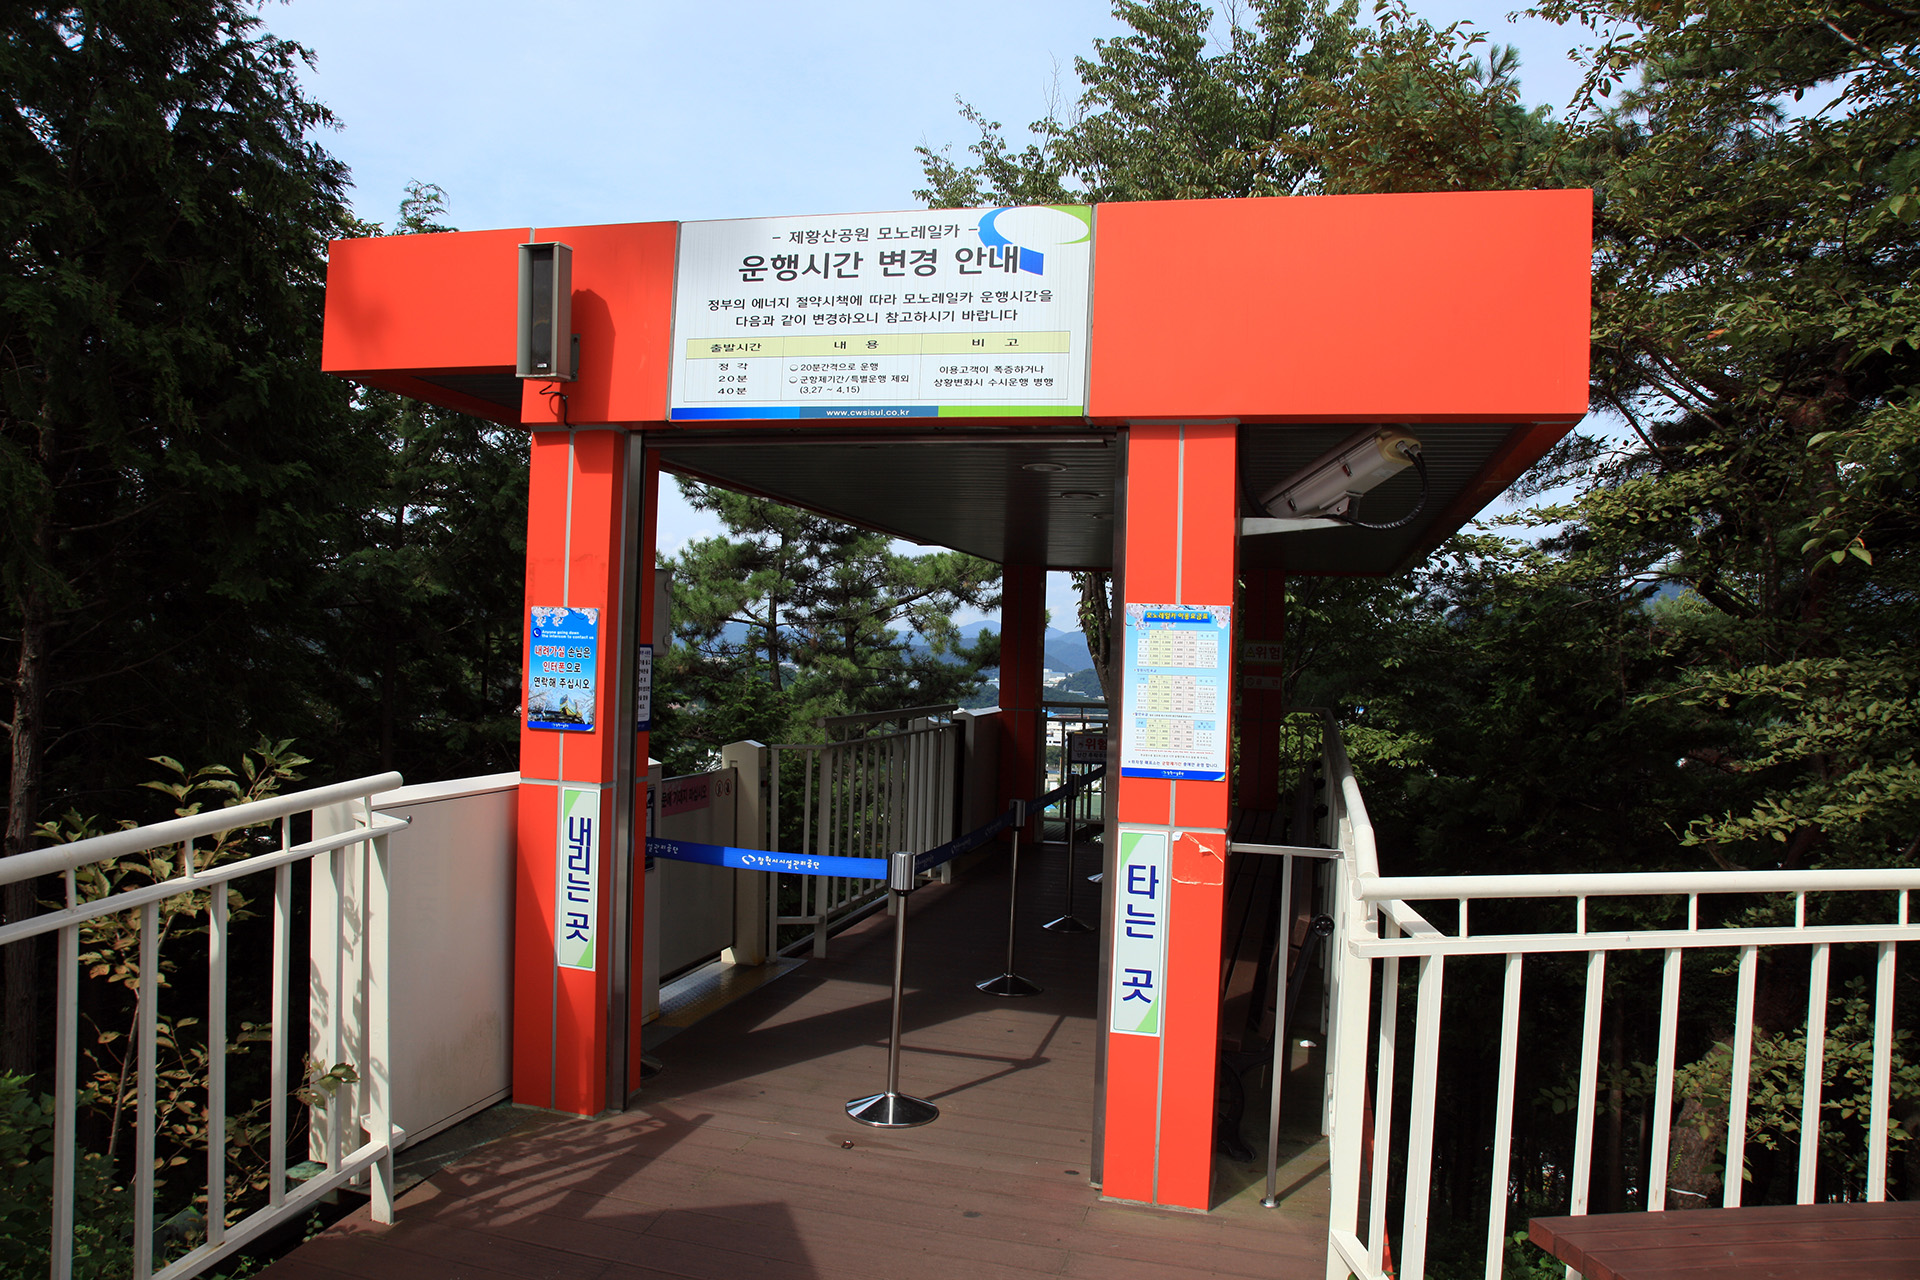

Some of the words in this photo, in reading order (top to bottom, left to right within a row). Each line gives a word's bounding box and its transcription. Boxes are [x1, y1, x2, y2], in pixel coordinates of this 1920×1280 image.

[789, 227, 869, 244] 제황산공원
[877, 224, 960, 240] 모노레일카
[738, 251, 864, 282] 운행시간
[879, 248, 937, 277] 변경
[955, 246, 1018, 275] 안내
[708, 298, 746, 311] 정부의
[751, 297, 790, 309] 에너지
[796, 294, 863, 308] 절약시책에
[869, 293, 897, 306] 따라
[903, 291, 973, 304] 모노레일카
[980, 289, 1053, 303] 운행시간을
[735, 315, 775, 327] 다음과
[781, 314, 806, 327] 같이
[812, 312, 878, 325] 변경하오니
[885, 310, 955, 324] 참고하시기
[961, 309, 1018, 322] 바랍니다
[710, 343, 762, 353] 출발시간
[800, 362, 856, 372] 20분간격으로
[860, 362, 879, 371] 운행
[939, 365, 989, 374] 이용고객이
[718, 375, 747, 383] 20분
[891, 374, 909, 383] 제외
[933, 378, 983, 387] 상황변화시
[988, 378, 1029, 387] 수시운행
[1033, 378, 1054, 387] 병행
[718, 387, 747, 395] 40분
[826, 409, 910, 417] www.cwsisul.co.kr
[1146, 612, 1177, 620] 모노레일카
[535, 645, 565, 658] 내려가실
[568, 646, 591, 659] 손님은
[1255, 646, 1280, 660] 위험
[542, 661, 581, 673] 인터폰으로
[533, 676, 557, 688] 연락해
[559, 677, 590, 690] 주십시오
[567, 816, 592, 903] 내리는
[1125, 864, 1159, 939] 타는
[565, 912, 590, 943] 곳
[1122, 968, 1153, 1004] 곳
